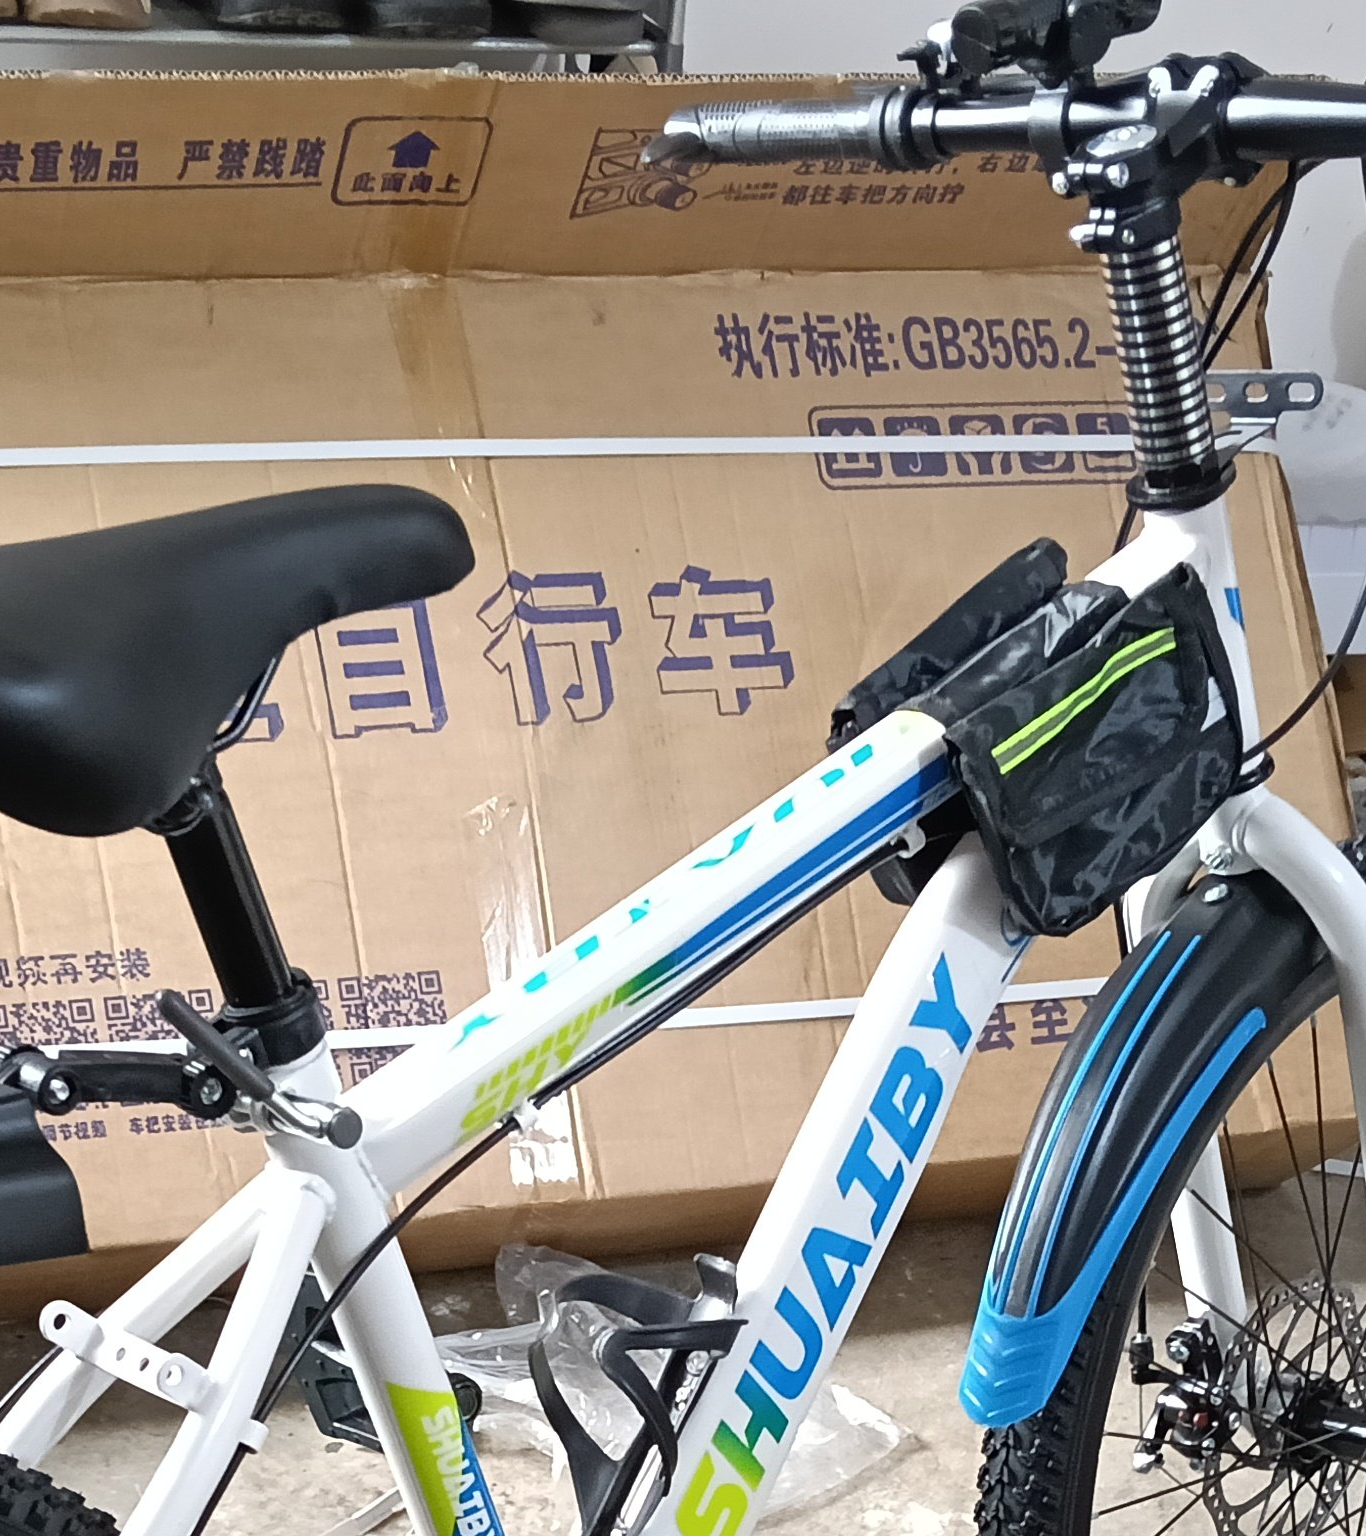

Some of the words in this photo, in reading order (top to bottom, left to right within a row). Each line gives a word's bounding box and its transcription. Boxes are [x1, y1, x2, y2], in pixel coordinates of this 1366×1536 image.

[177, 136, 326, 181] 严禁践踏
[349, 171, 464, 194] 此面向上
[781, 183, 965, 206] 都往车把方向拧
